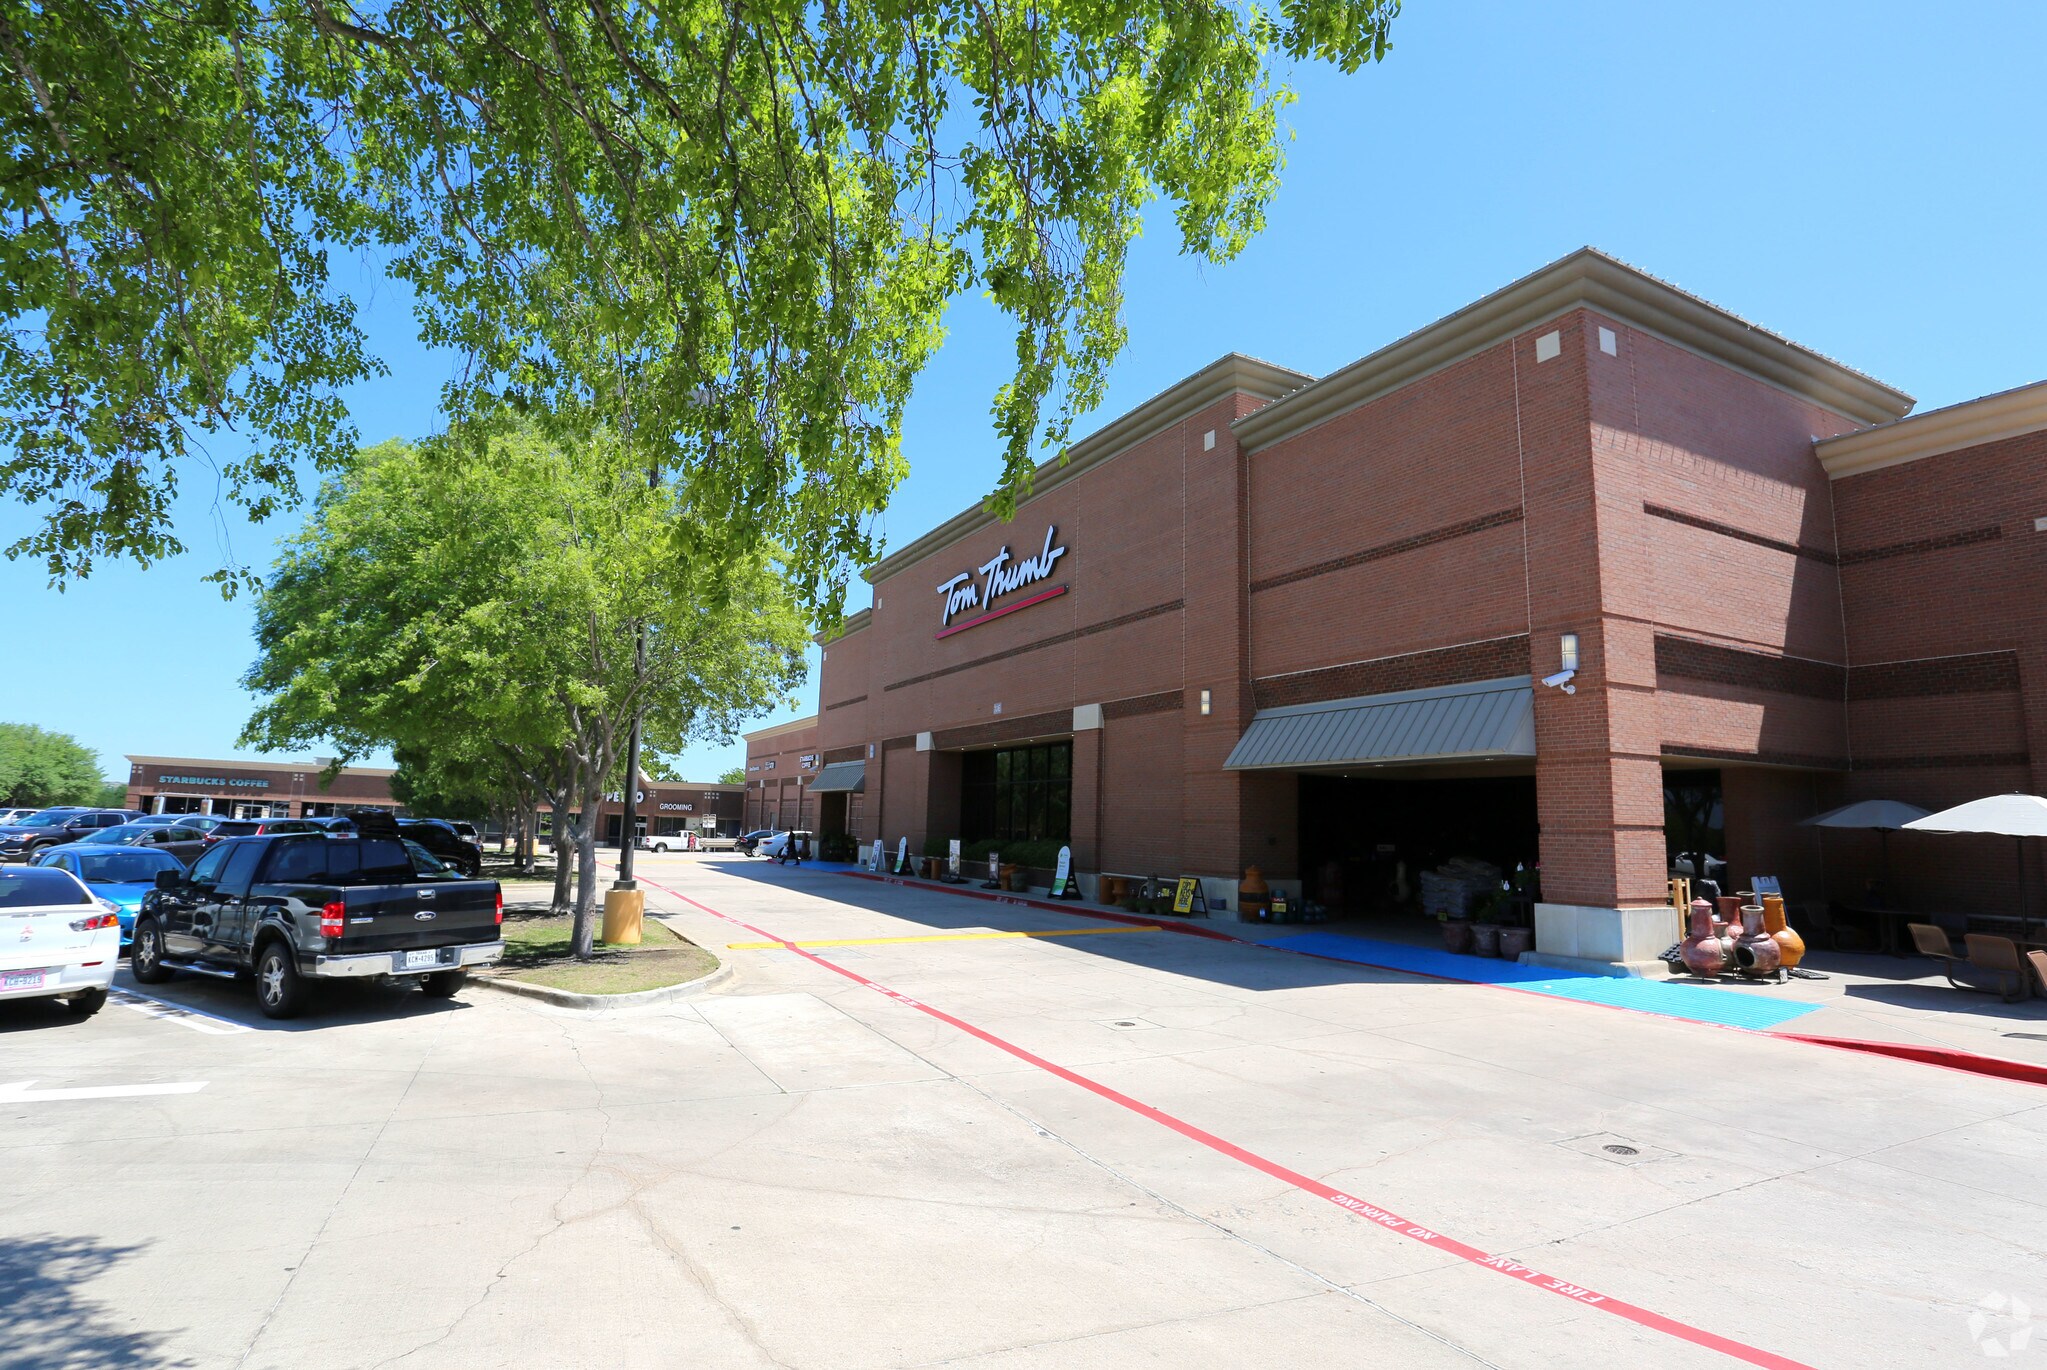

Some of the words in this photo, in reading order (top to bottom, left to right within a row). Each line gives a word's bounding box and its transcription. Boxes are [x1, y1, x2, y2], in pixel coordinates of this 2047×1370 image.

[937, 573, 978, 626] Tom
[978, 525, 1065, 610] Thumb
[158, 775, 226, 786] STARBUCKS
[228, 779, 269, 788] COFFEE
[606, 790, 644, 803] PEO
[659, 803, 693, 811] GROOMING
[1330, 1194, 1406, 1227] PARKING
[1406, 1228, 1438, 1240] NO
[1475, 1255, 1541, 1279] LANE
[1543, 1279, 1605, 1303] FIRE
